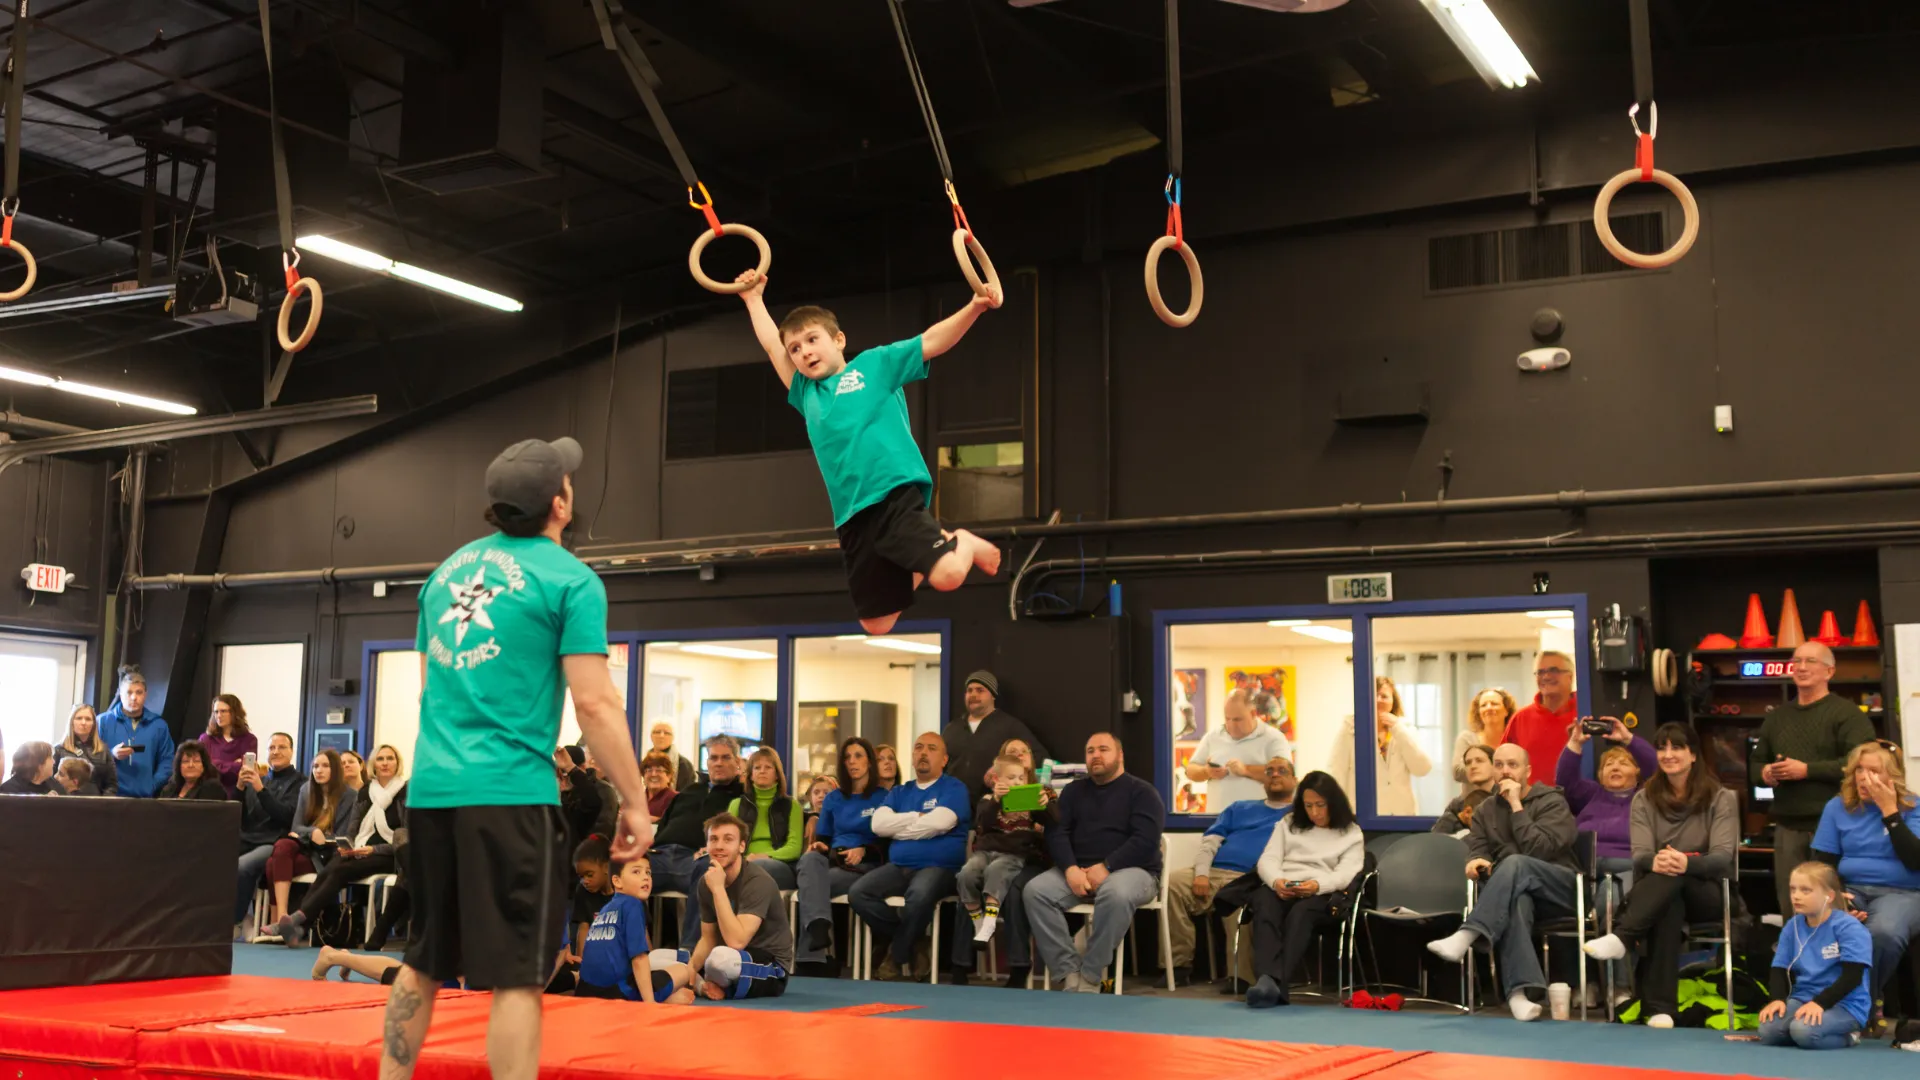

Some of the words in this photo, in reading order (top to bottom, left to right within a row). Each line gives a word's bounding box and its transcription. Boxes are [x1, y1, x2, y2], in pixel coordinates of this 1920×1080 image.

[36, 566, 61, 590] EXIT
[436, 549, 480, 587] SOUTH
[482, 548, 526, 594] WINDSOR
[1743, 662, 1763, 676] 00
[1765, 662, 1784, 675] 00
